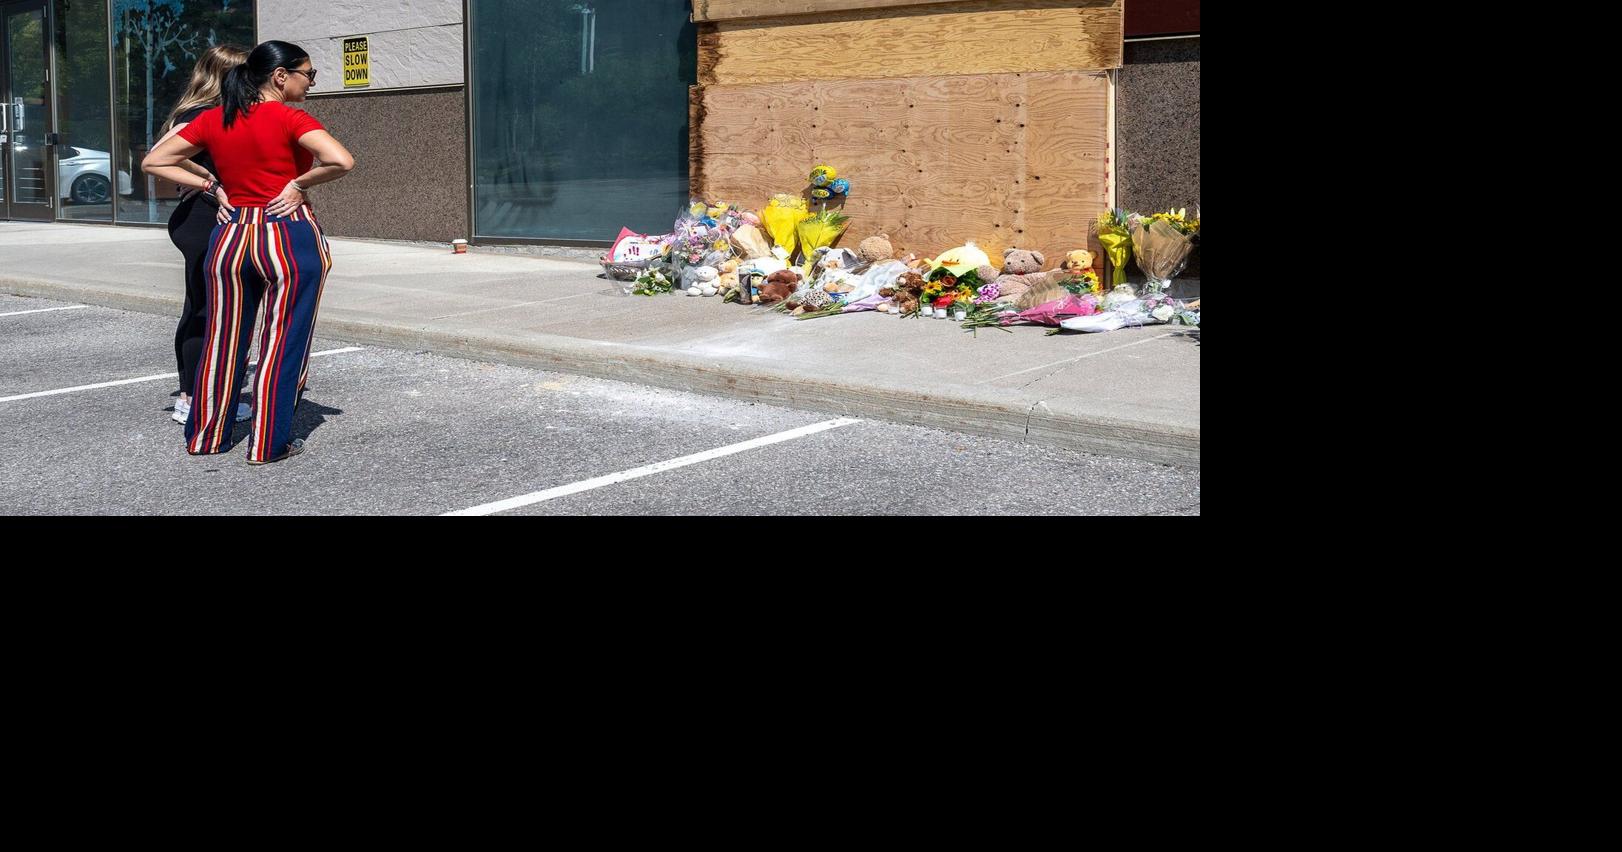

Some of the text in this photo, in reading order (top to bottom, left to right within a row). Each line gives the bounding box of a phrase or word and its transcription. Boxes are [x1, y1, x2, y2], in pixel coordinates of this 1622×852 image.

[345, 40, 367, 51] PLEASE
[345, 53, 368, 66] SLOW
[345, 68, 368, 80] DOWN
